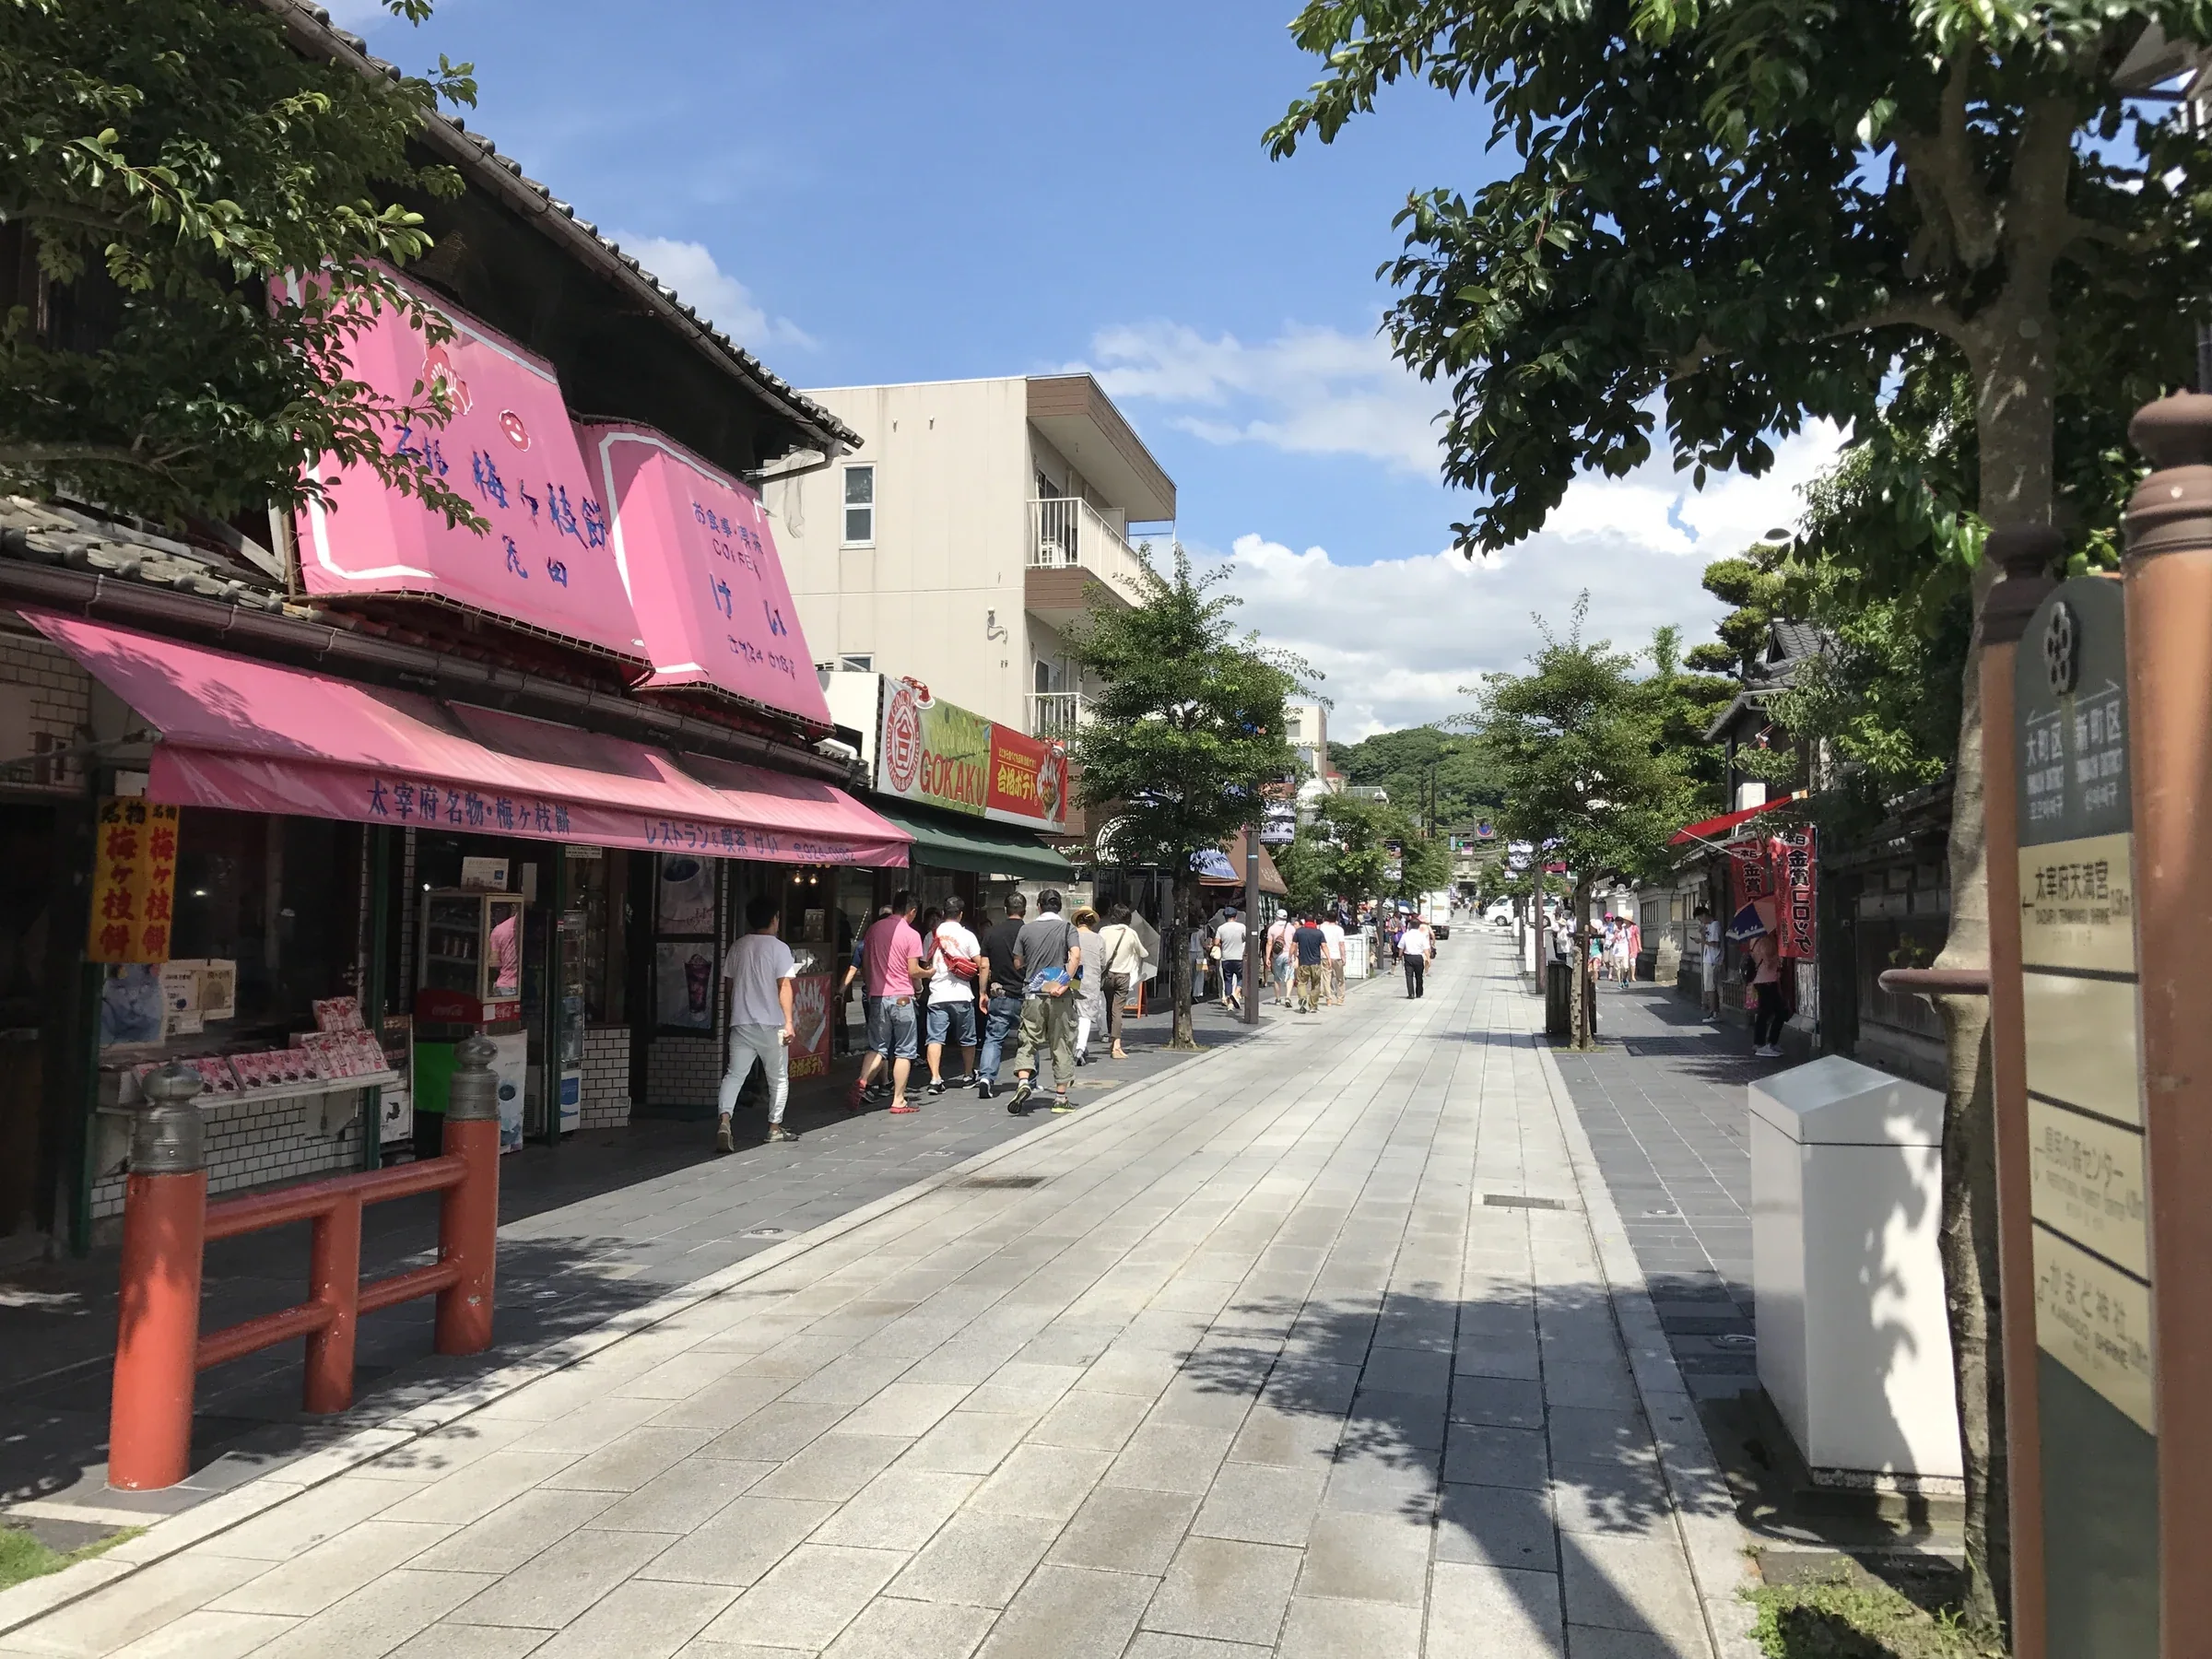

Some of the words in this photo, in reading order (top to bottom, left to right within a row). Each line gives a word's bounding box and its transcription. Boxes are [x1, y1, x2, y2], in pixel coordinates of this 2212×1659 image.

[709, 572, 787, 637] けい
[920, 748, 987, 808] GOKAKU
[996, 763, 1036, 801] 合格ポテト
